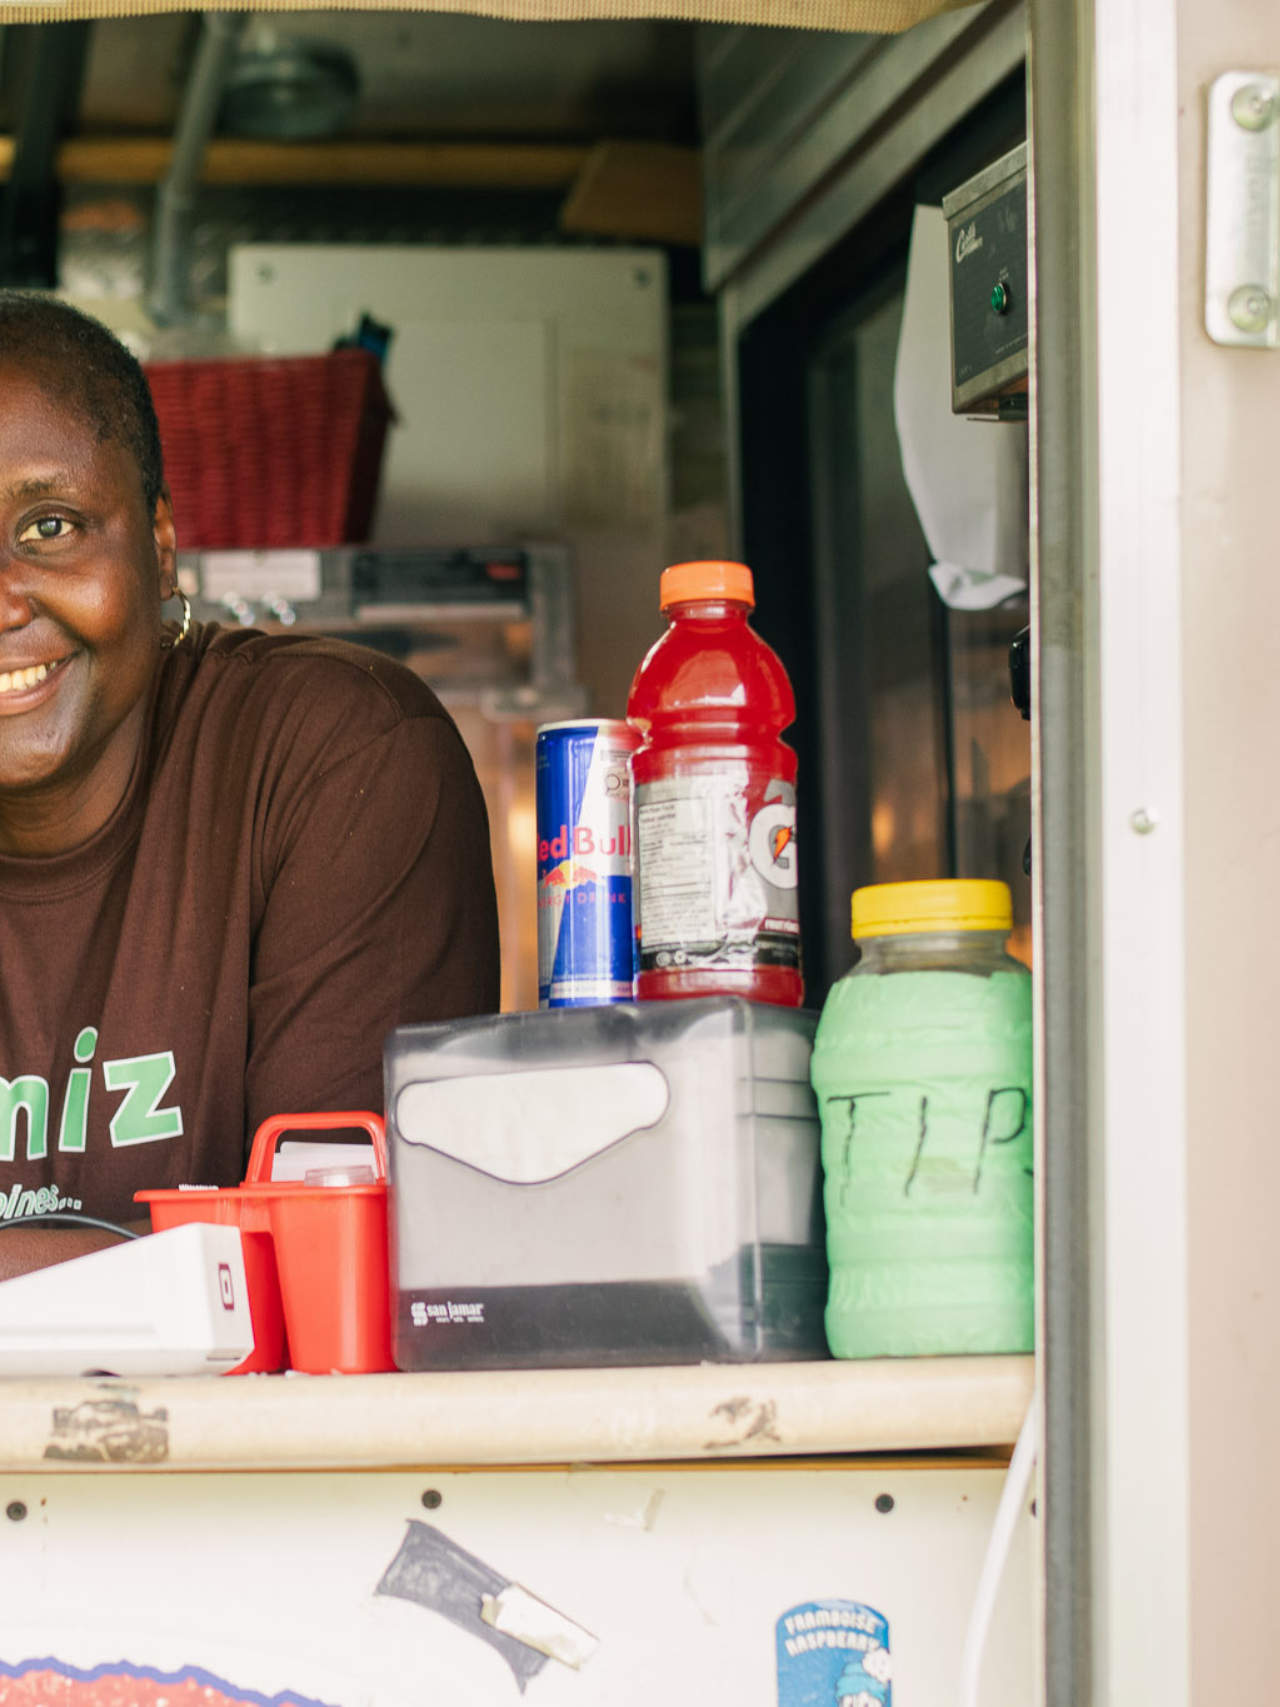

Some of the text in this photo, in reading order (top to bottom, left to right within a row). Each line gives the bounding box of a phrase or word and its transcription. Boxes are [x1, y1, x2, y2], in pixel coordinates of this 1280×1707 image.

[537, 825, 631, 861] ed Bull
[749, 803, 798, 889] G
[577, 892, 627, 904] DRNK
[426, 1300, 485, 1319] san jamar
[784, 1608, 878, 1636] FRAMBOISE
[784, 1629, 880, 1657] RASPBERRY
